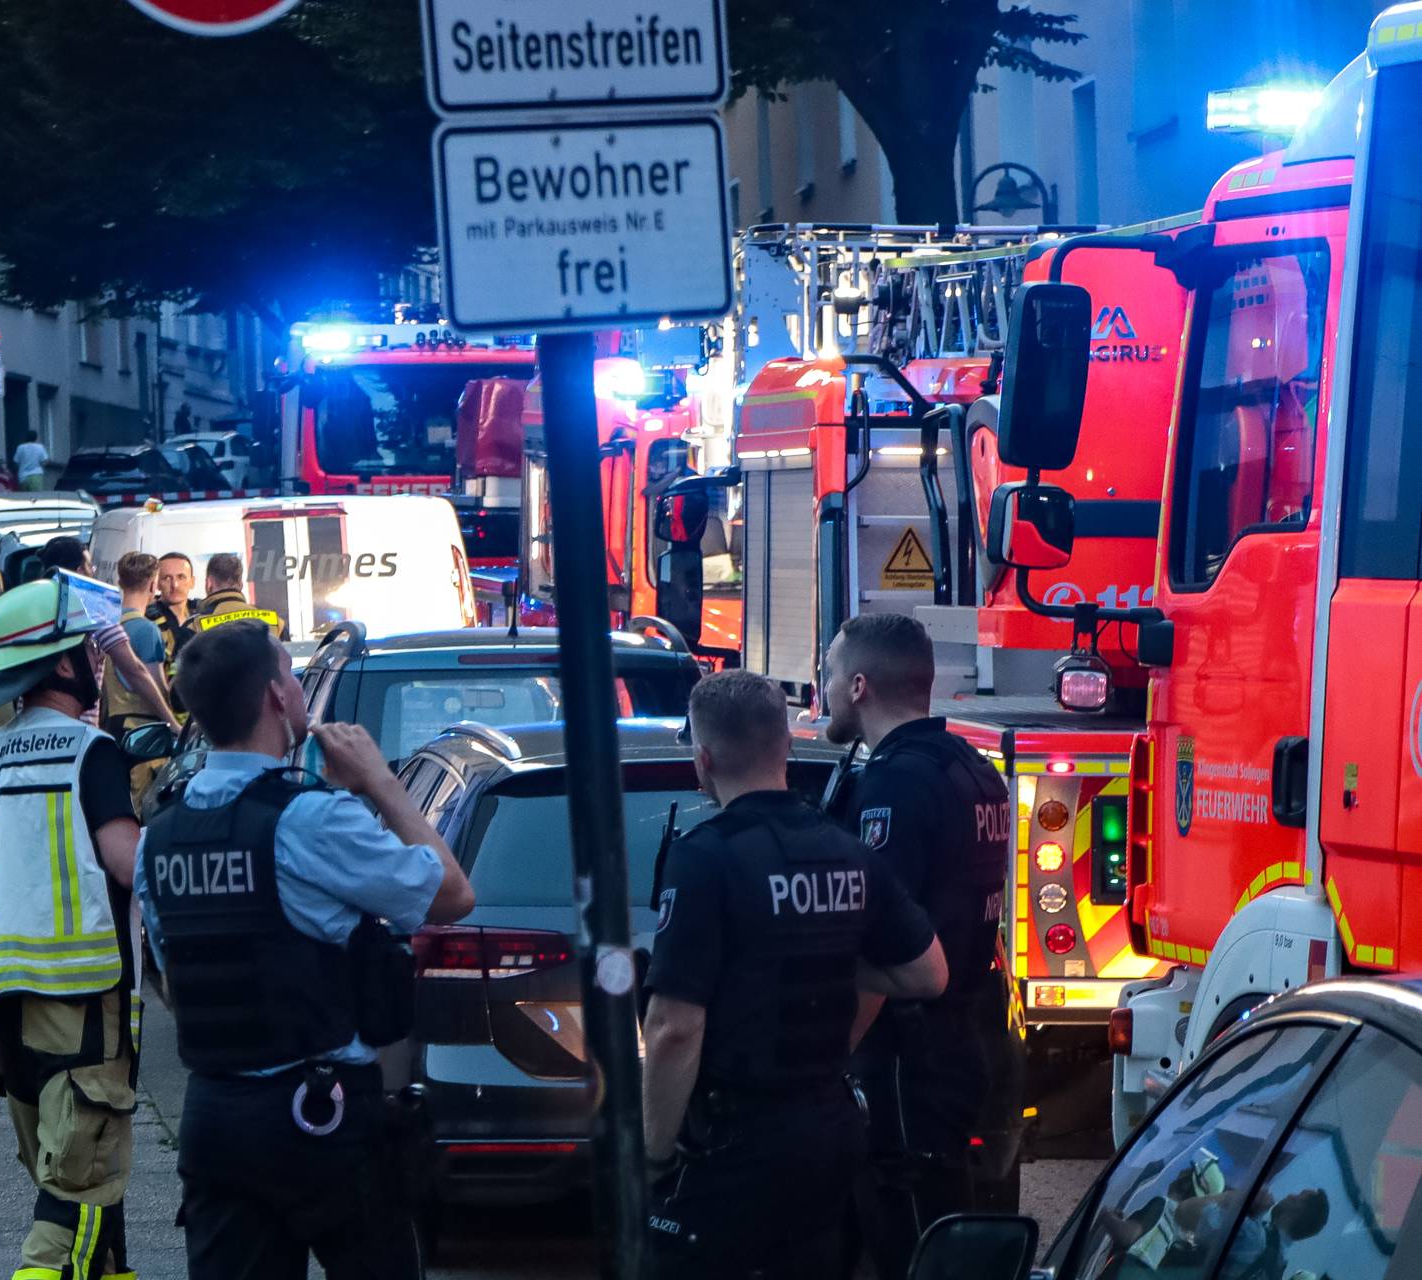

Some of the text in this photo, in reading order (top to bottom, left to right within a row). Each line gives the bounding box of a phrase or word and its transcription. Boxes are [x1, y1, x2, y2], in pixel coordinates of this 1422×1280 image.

[451, 15, 703, 72] Seitenstreifen
[474, 151, 690, 204] Bewohner
[467, 221, 496, 241] mit
[504, 211, 619, 238] Parkausweis
[558, 246, 628, 296] frei
[246, 549, 398, 583] Hermes
[1196, 788, 1269, 825] FEUERWEHR
[154, 850, 255, 897] POLIZEI
[768, 870, 866, 915] POLIZEI
